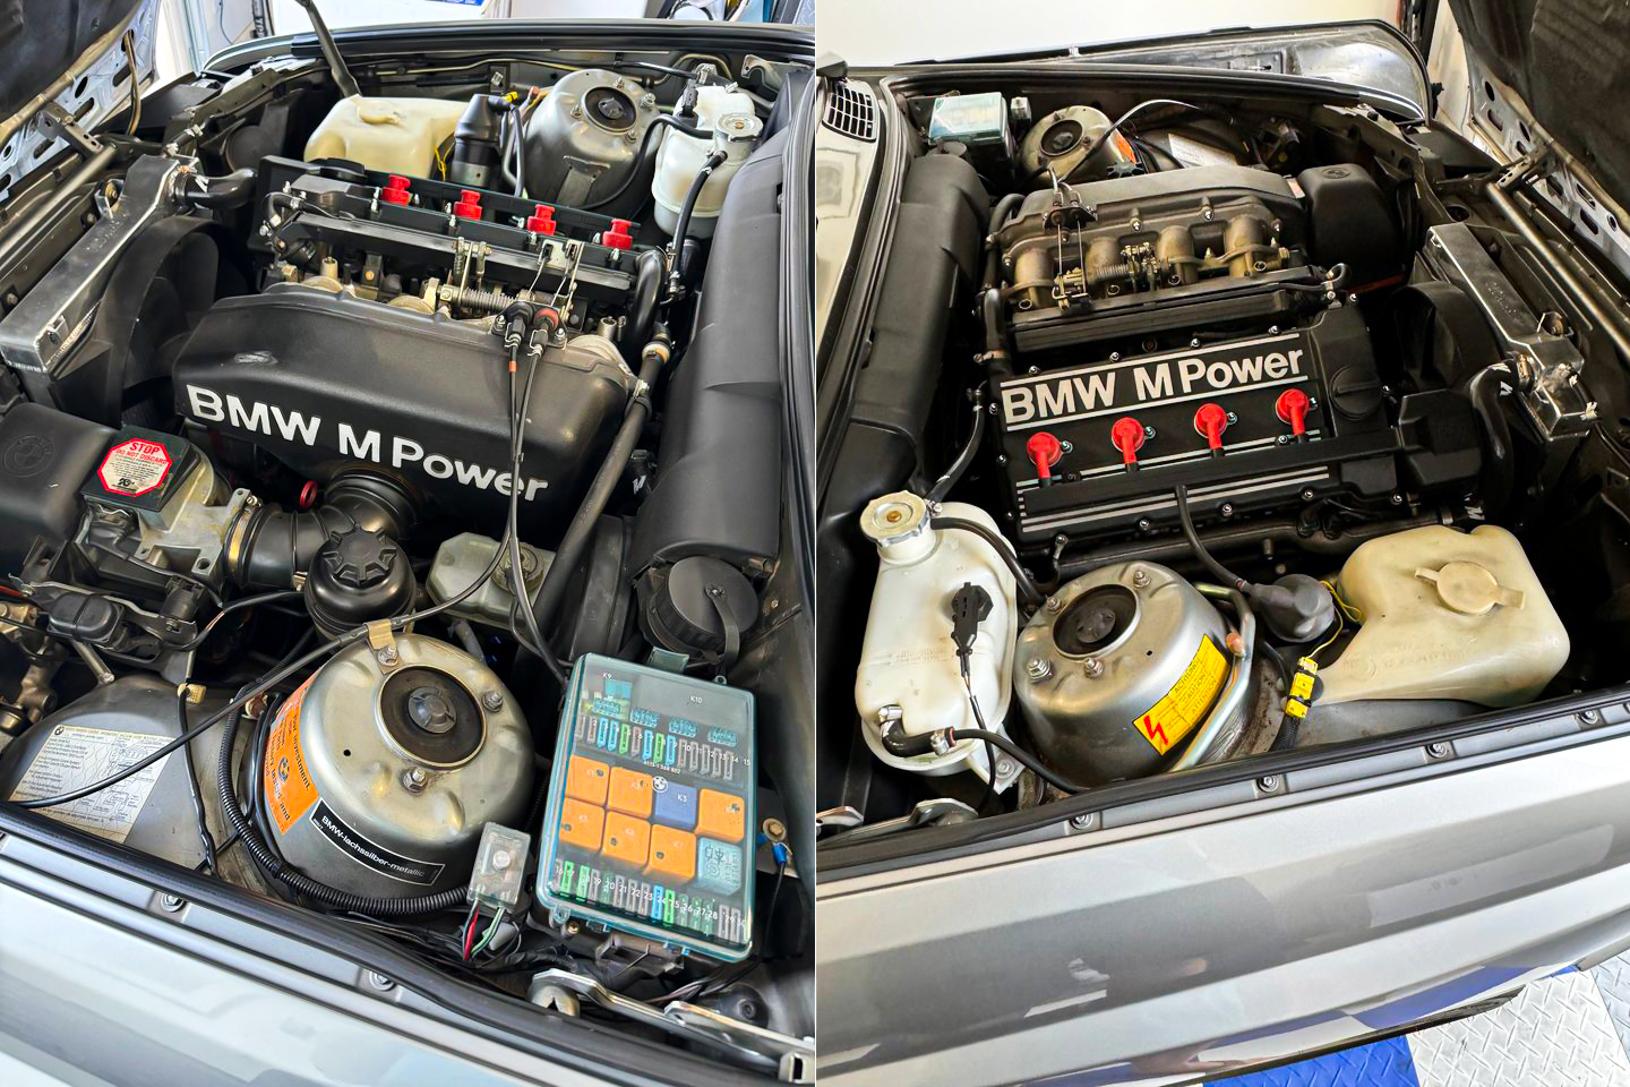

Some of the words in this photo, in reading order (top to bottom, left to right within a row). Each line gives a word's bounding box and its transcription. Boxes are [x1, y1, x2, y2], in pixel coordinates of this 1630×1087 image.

[1001, 372, 1116, 424] BMW
[186, 384, 321, 446] BMW
[130, 442, 160, 455] STOP
[690, 695, 703, 704] K10
[280, 803, 291, 821] and
